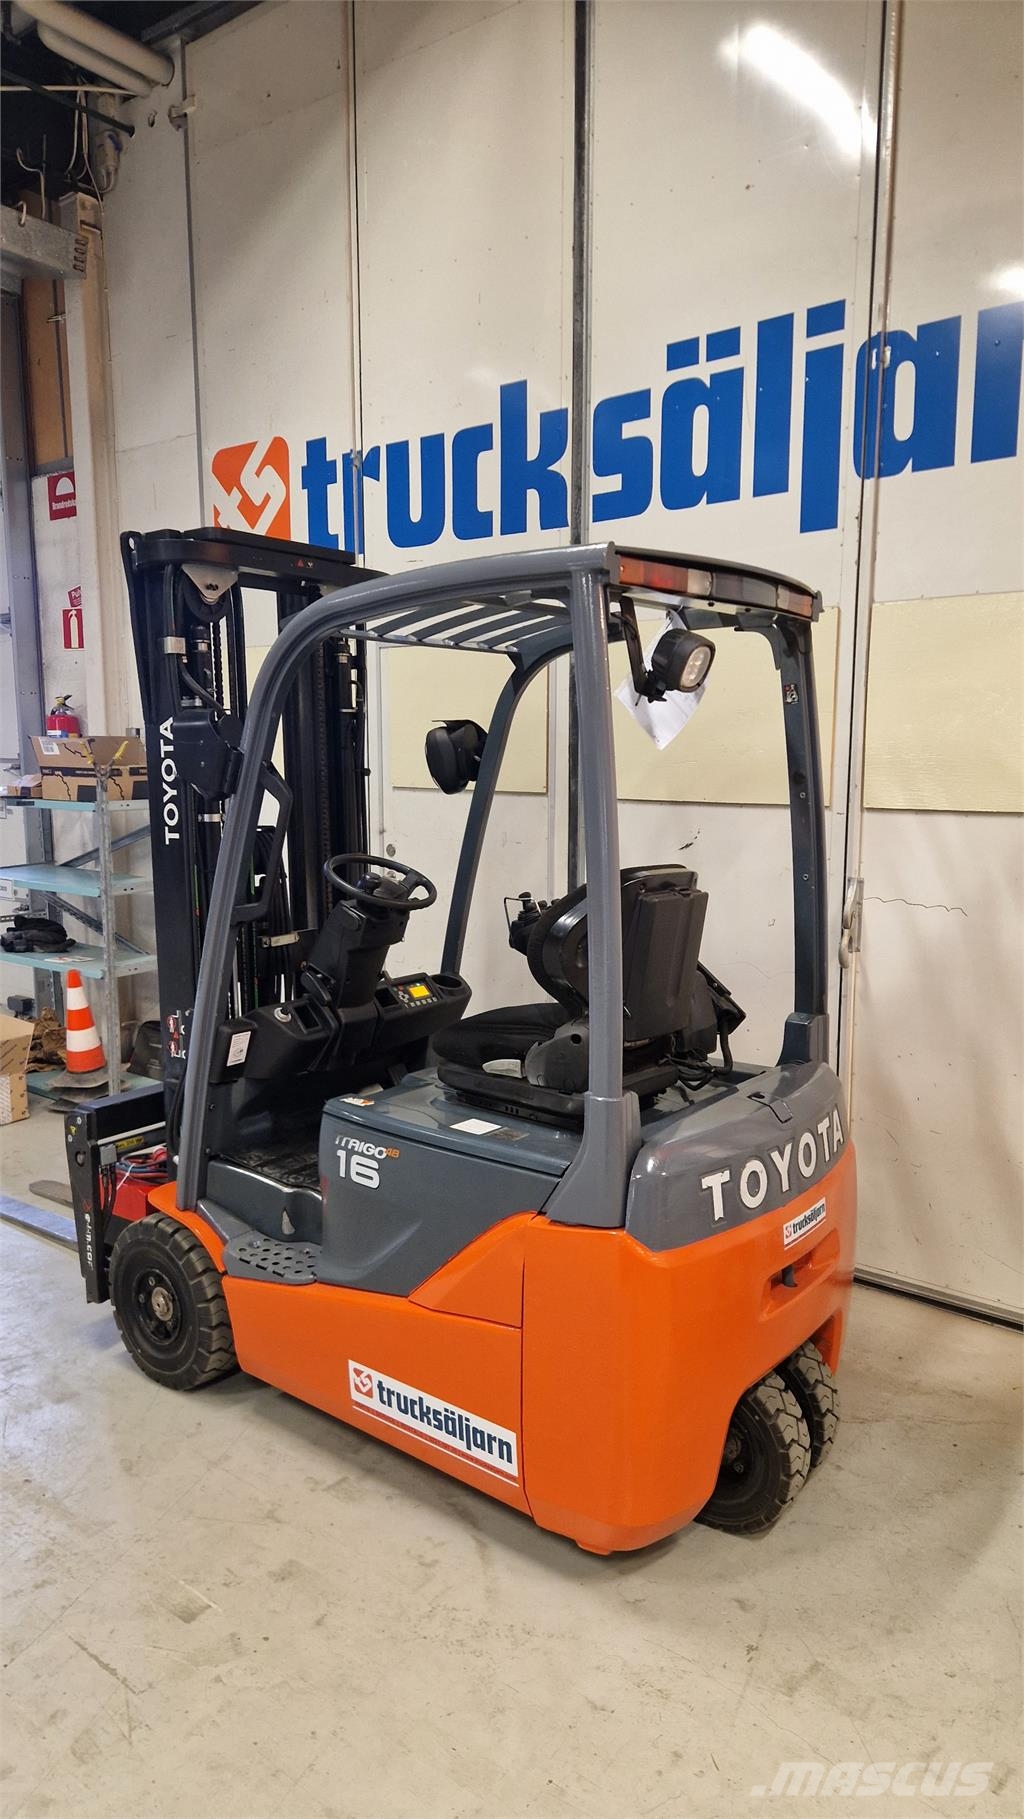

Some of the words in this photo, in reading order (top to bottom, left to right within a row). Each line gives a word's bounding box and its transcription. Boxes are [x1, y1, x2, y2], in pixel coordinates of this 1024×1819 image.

[159, 716, 180, 845] TOYOTA
[337, 1150, 380, 1189] 16
[701, 1106, 844, 1222] TOYOTA
[376, 1380, 513, 1464] trucksäljarn
